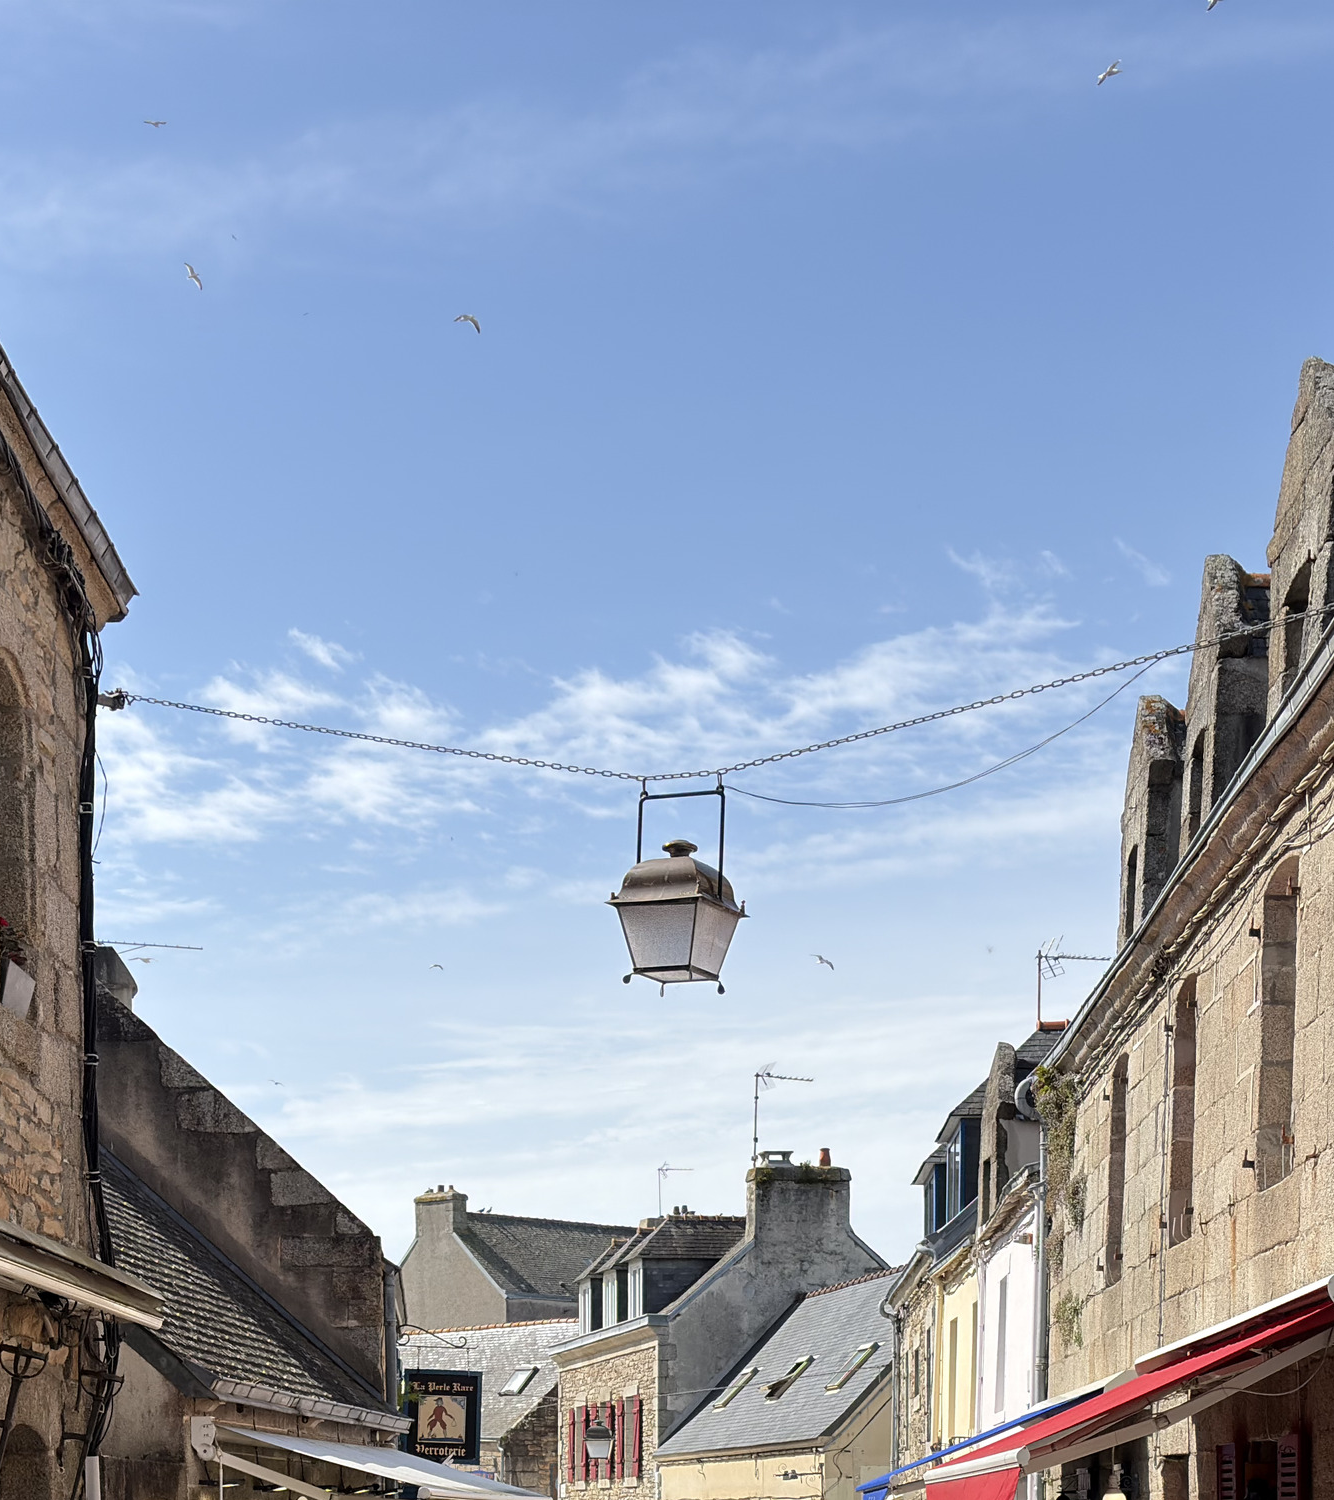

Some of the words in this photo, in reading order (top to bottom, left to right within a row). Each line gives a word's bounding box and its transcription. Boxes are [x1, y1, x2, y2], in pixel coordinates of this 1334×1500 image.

[413, 1382, 425, 1390] La
[428, 1382, 451, 1393] Perle
[452, 1383, 474, 1393] Rare
